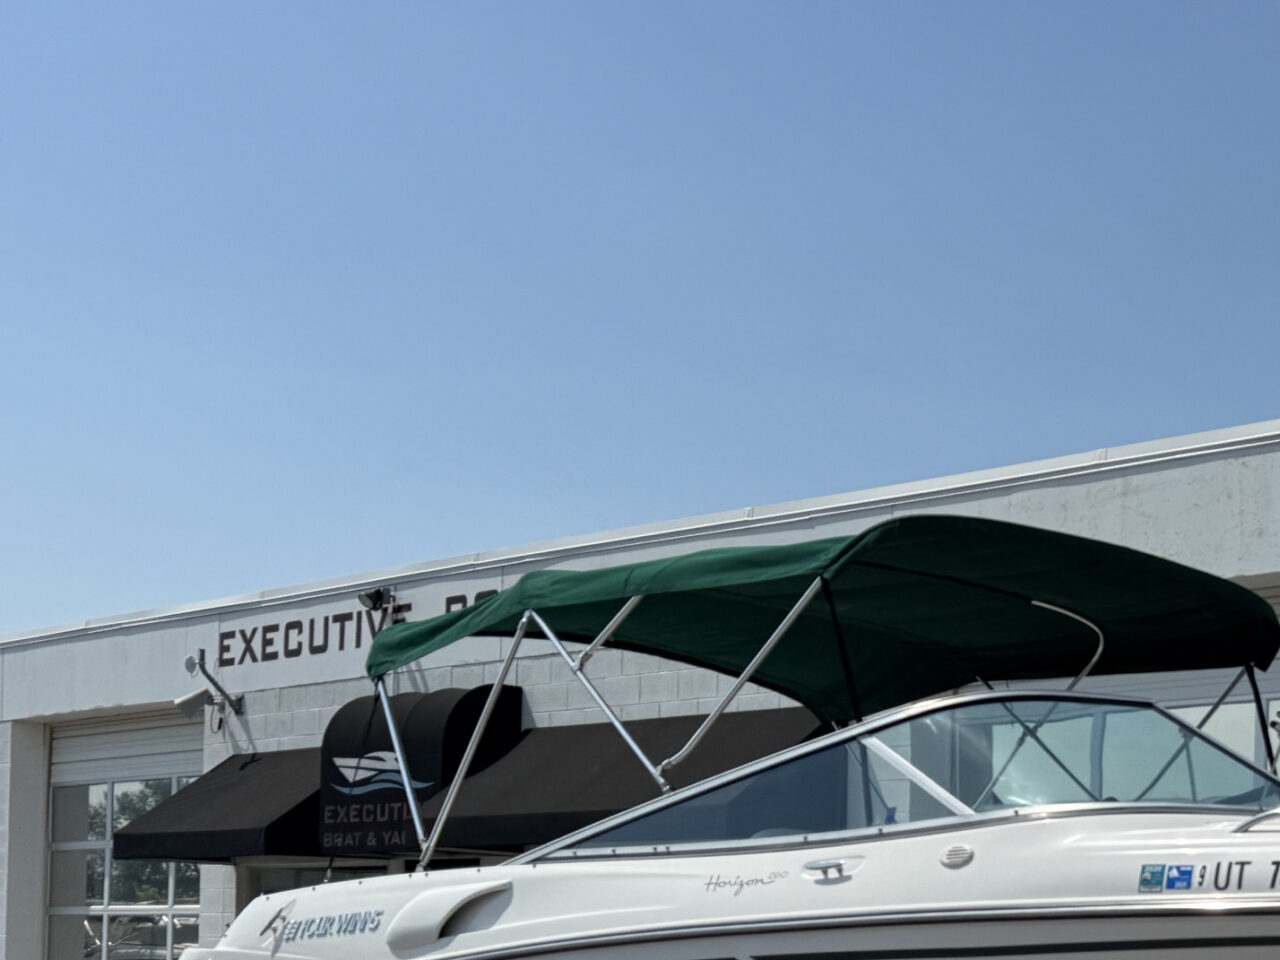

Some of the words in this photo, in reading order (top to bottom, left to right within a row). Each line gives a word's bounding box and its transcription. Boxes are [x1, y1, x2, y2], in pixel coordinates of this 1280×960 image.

[323, 803, 412, 824] EXECUTI
[704, 875, 774, 897] Horizon
[1213, 861, 1252, 891] UT
